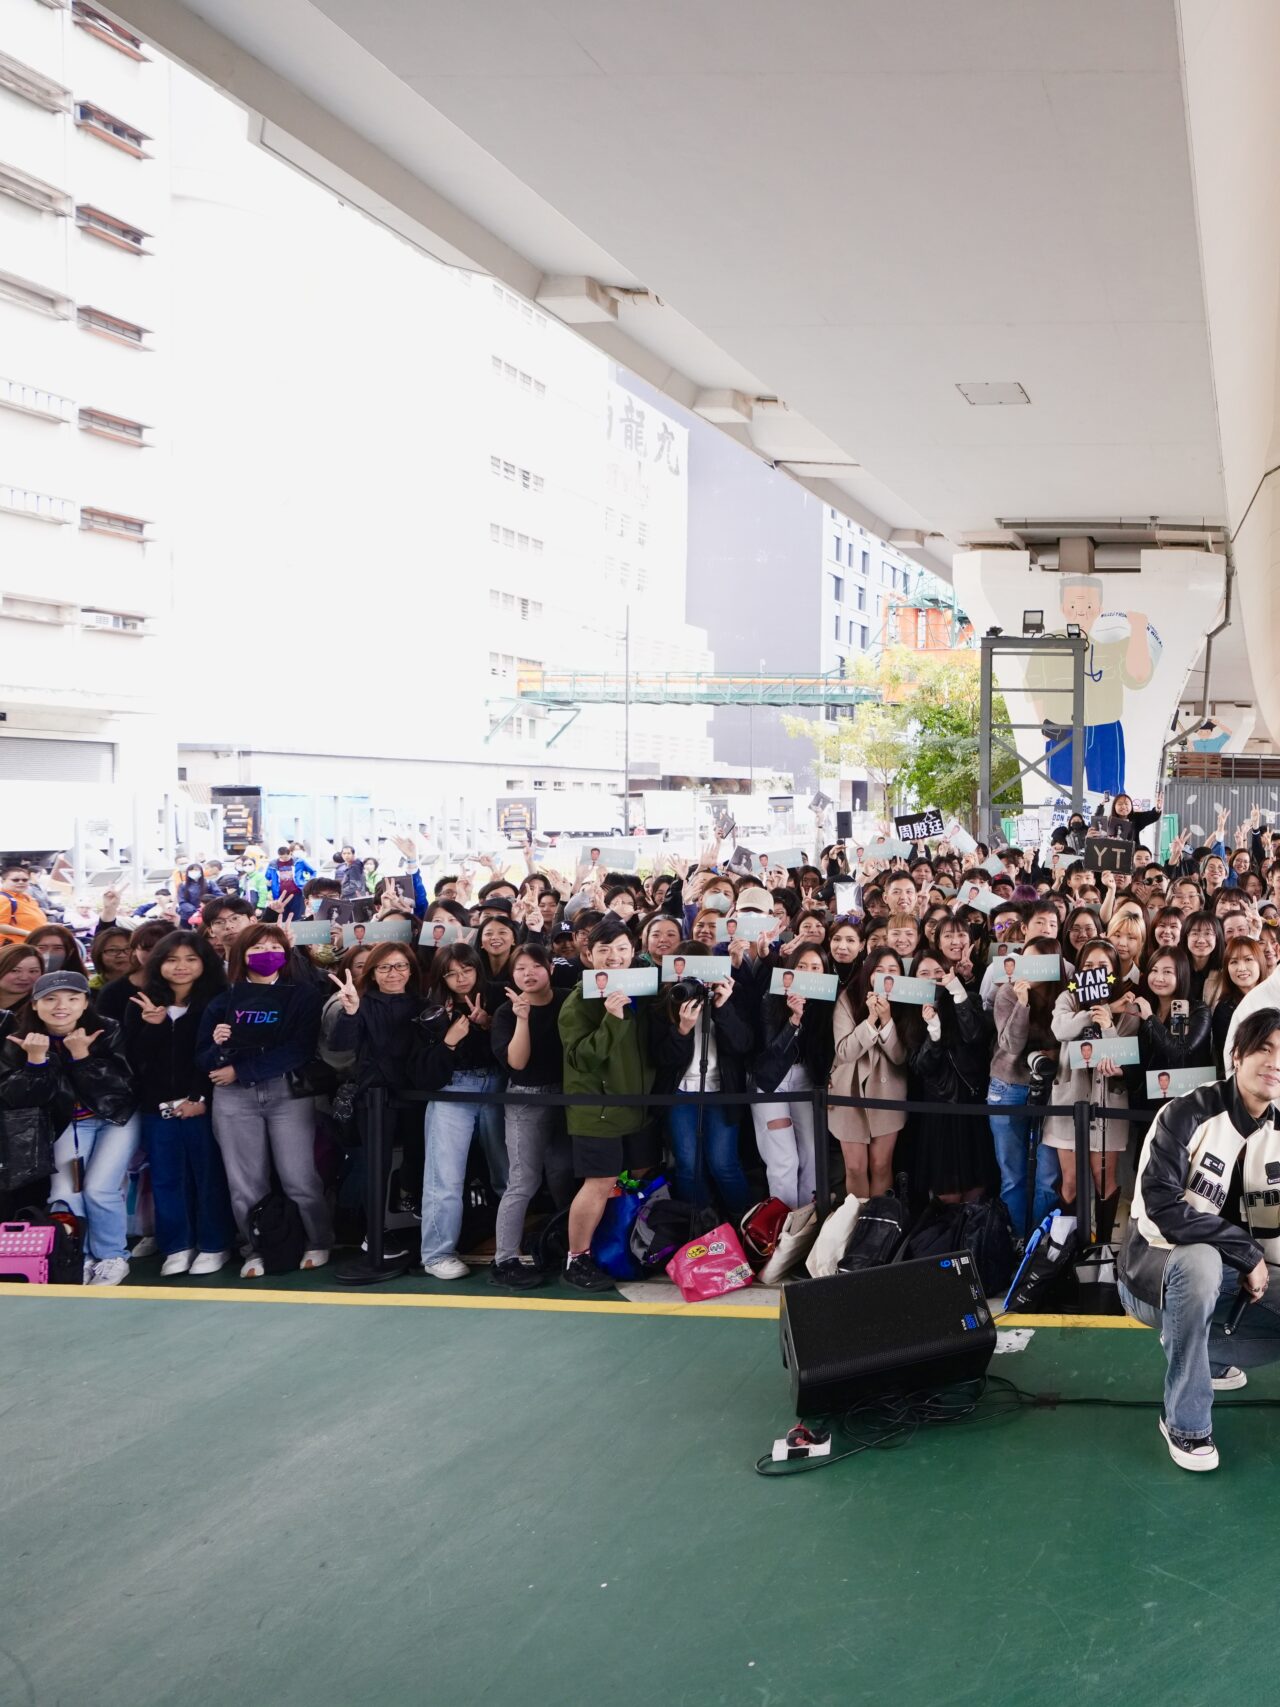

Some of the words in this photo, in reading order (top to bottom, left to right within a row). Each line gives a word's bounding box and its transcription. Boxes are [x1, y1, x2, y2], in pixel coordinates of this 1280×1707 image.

[1093, 845, 1126, 869] YT
[561, 921, 570, 931] LA
[1074, 968, 1106, 987] YAN
[1075, 983, 1110, 1003] TING
